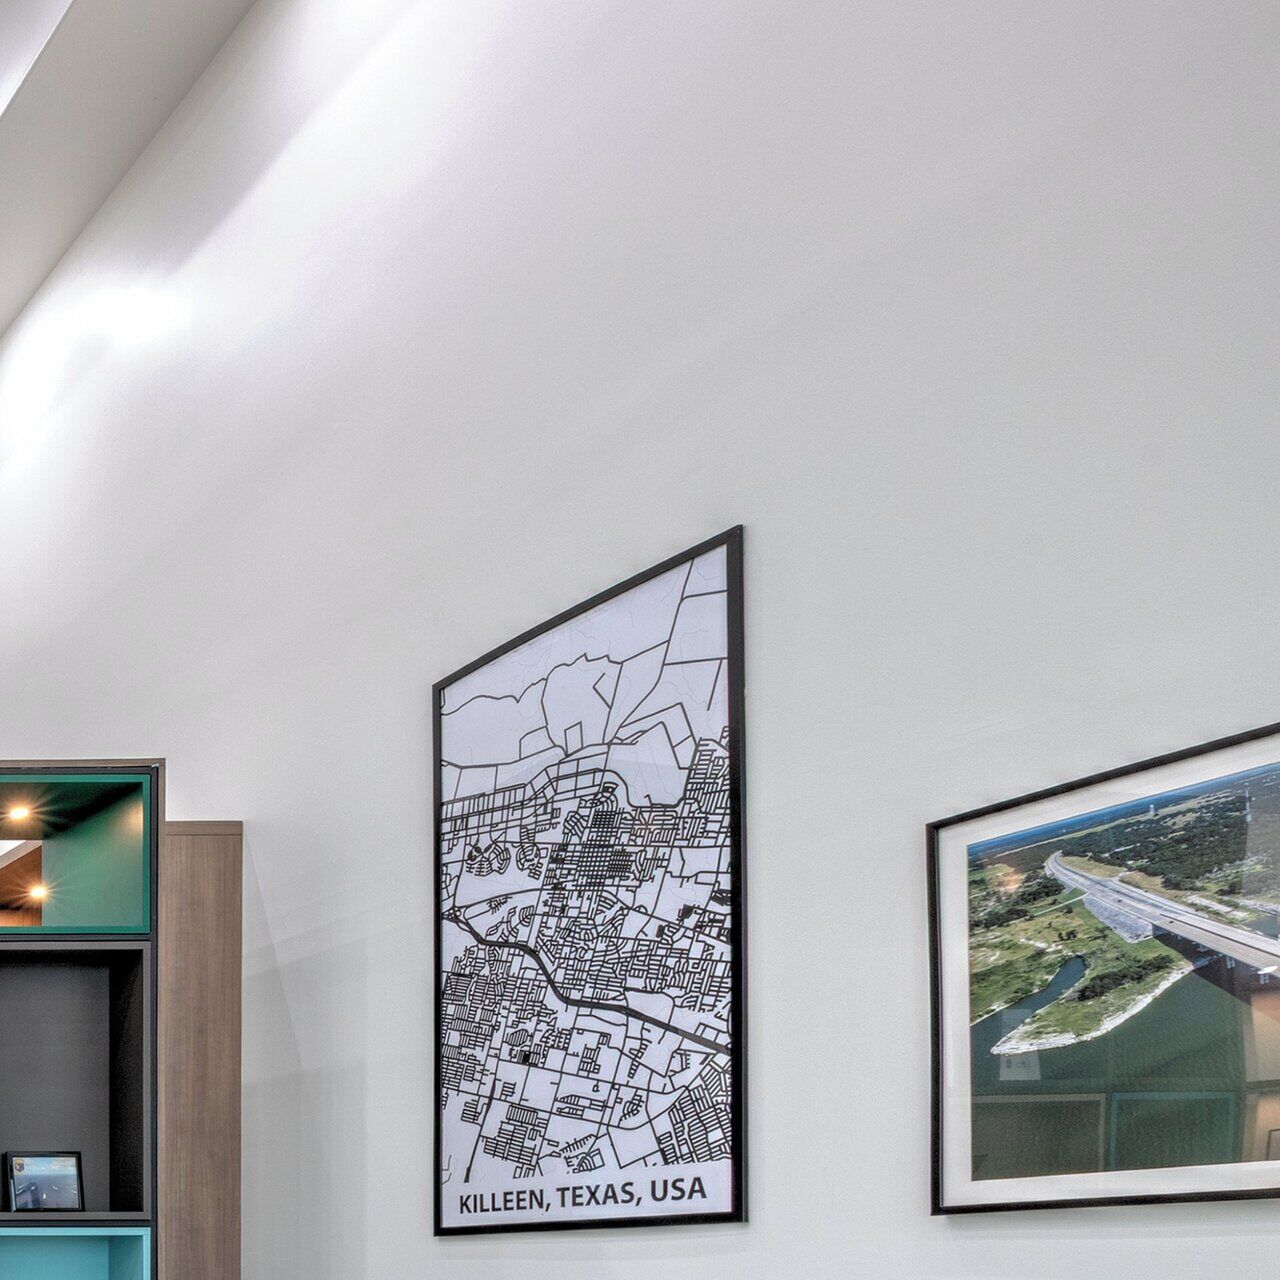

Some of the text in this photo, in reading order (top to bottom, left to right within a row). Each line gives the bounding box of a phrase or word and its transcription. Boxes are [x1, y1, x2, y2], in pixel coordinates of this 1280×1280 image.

[459, 1177, 707, 1214] KILLEEN, TEXAS, USA
